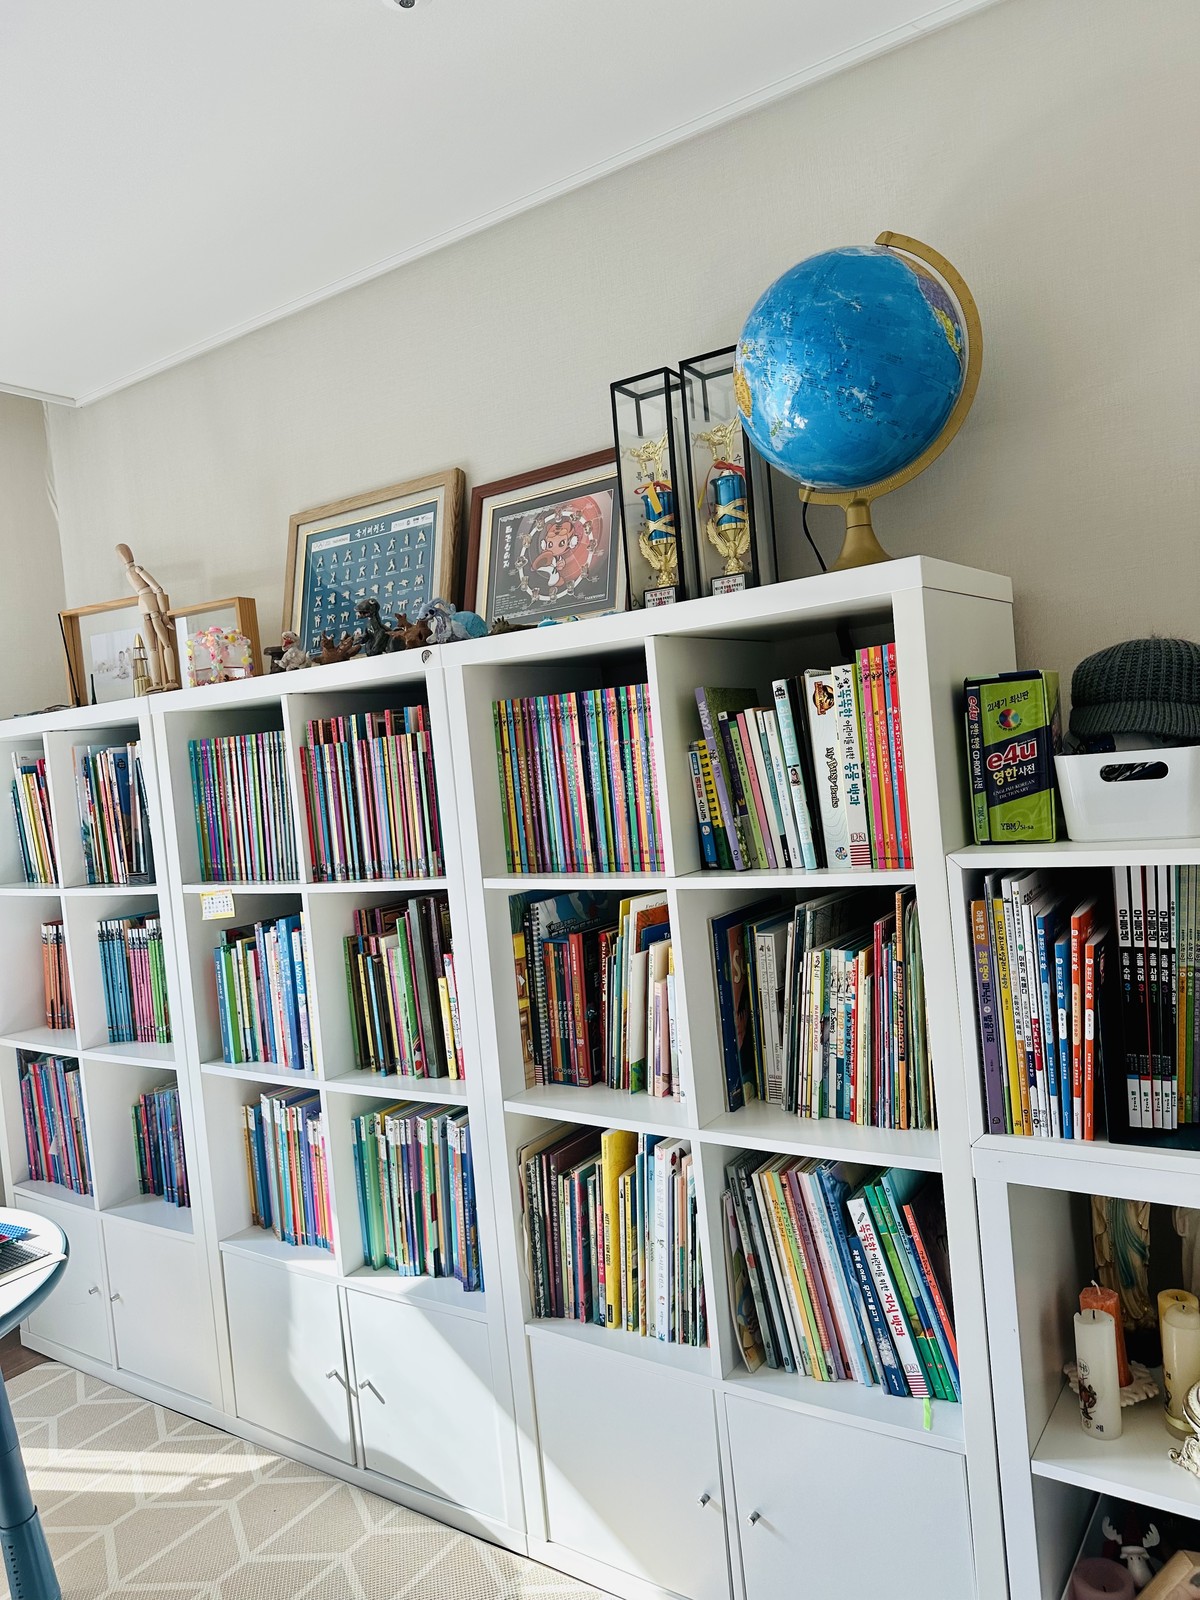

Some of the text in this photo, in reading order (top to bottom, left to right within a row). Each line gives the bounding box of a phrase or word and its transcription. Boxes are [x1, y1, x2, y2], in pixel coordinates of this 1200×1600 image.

[1009, 690, 1030, 704] 최신판
[697, 700, 712, 731] who?
[967, 695, 979, 721] e4u
[836, 688, 861, 806] 똑똑한 어린이를 위한 동물 백과
[986, 740, 1037, 770] e4u
[972, 750, 981, 775] CD-ROM
[973, 776, 983, 789] 사전
[993, 764, 1036, 786] 영한 사전
[1001, 822, 1017, 831] YBM
[974, 909, 984, 940] 하루 한 장
[1119, 909, 1129, 941] 우등생
[1134, 909, 1144, 941] 우등생
[1148, 909, 1157, 941] 우등생
[1160, 911, 1168, 942] 우등생
[977, 950, 987, 965] 초등
[1123, 952, 1130, 966] 초등
[1136, 953, 1144, 966] 초등
[1150, 953, 1157, 966] 초등
[1161, 954, 1168, 967] 초등
[294, 964, 303, 990] Why?
[979, 965, 988, 981] 영어
[1123, 967, 1130, 980] 수학
[1137, 968, 1144, 981] 국어
[1150, 968, 1157, 981] 사회
[980, 982, 990, 1004] 파닉스
[845, 1038, 851, 1050] My
[857, 1222, 905, 1338] 똑똑한 어린이를 위한 지식 백과
[867, 1303, 880, 1322] 물고기
